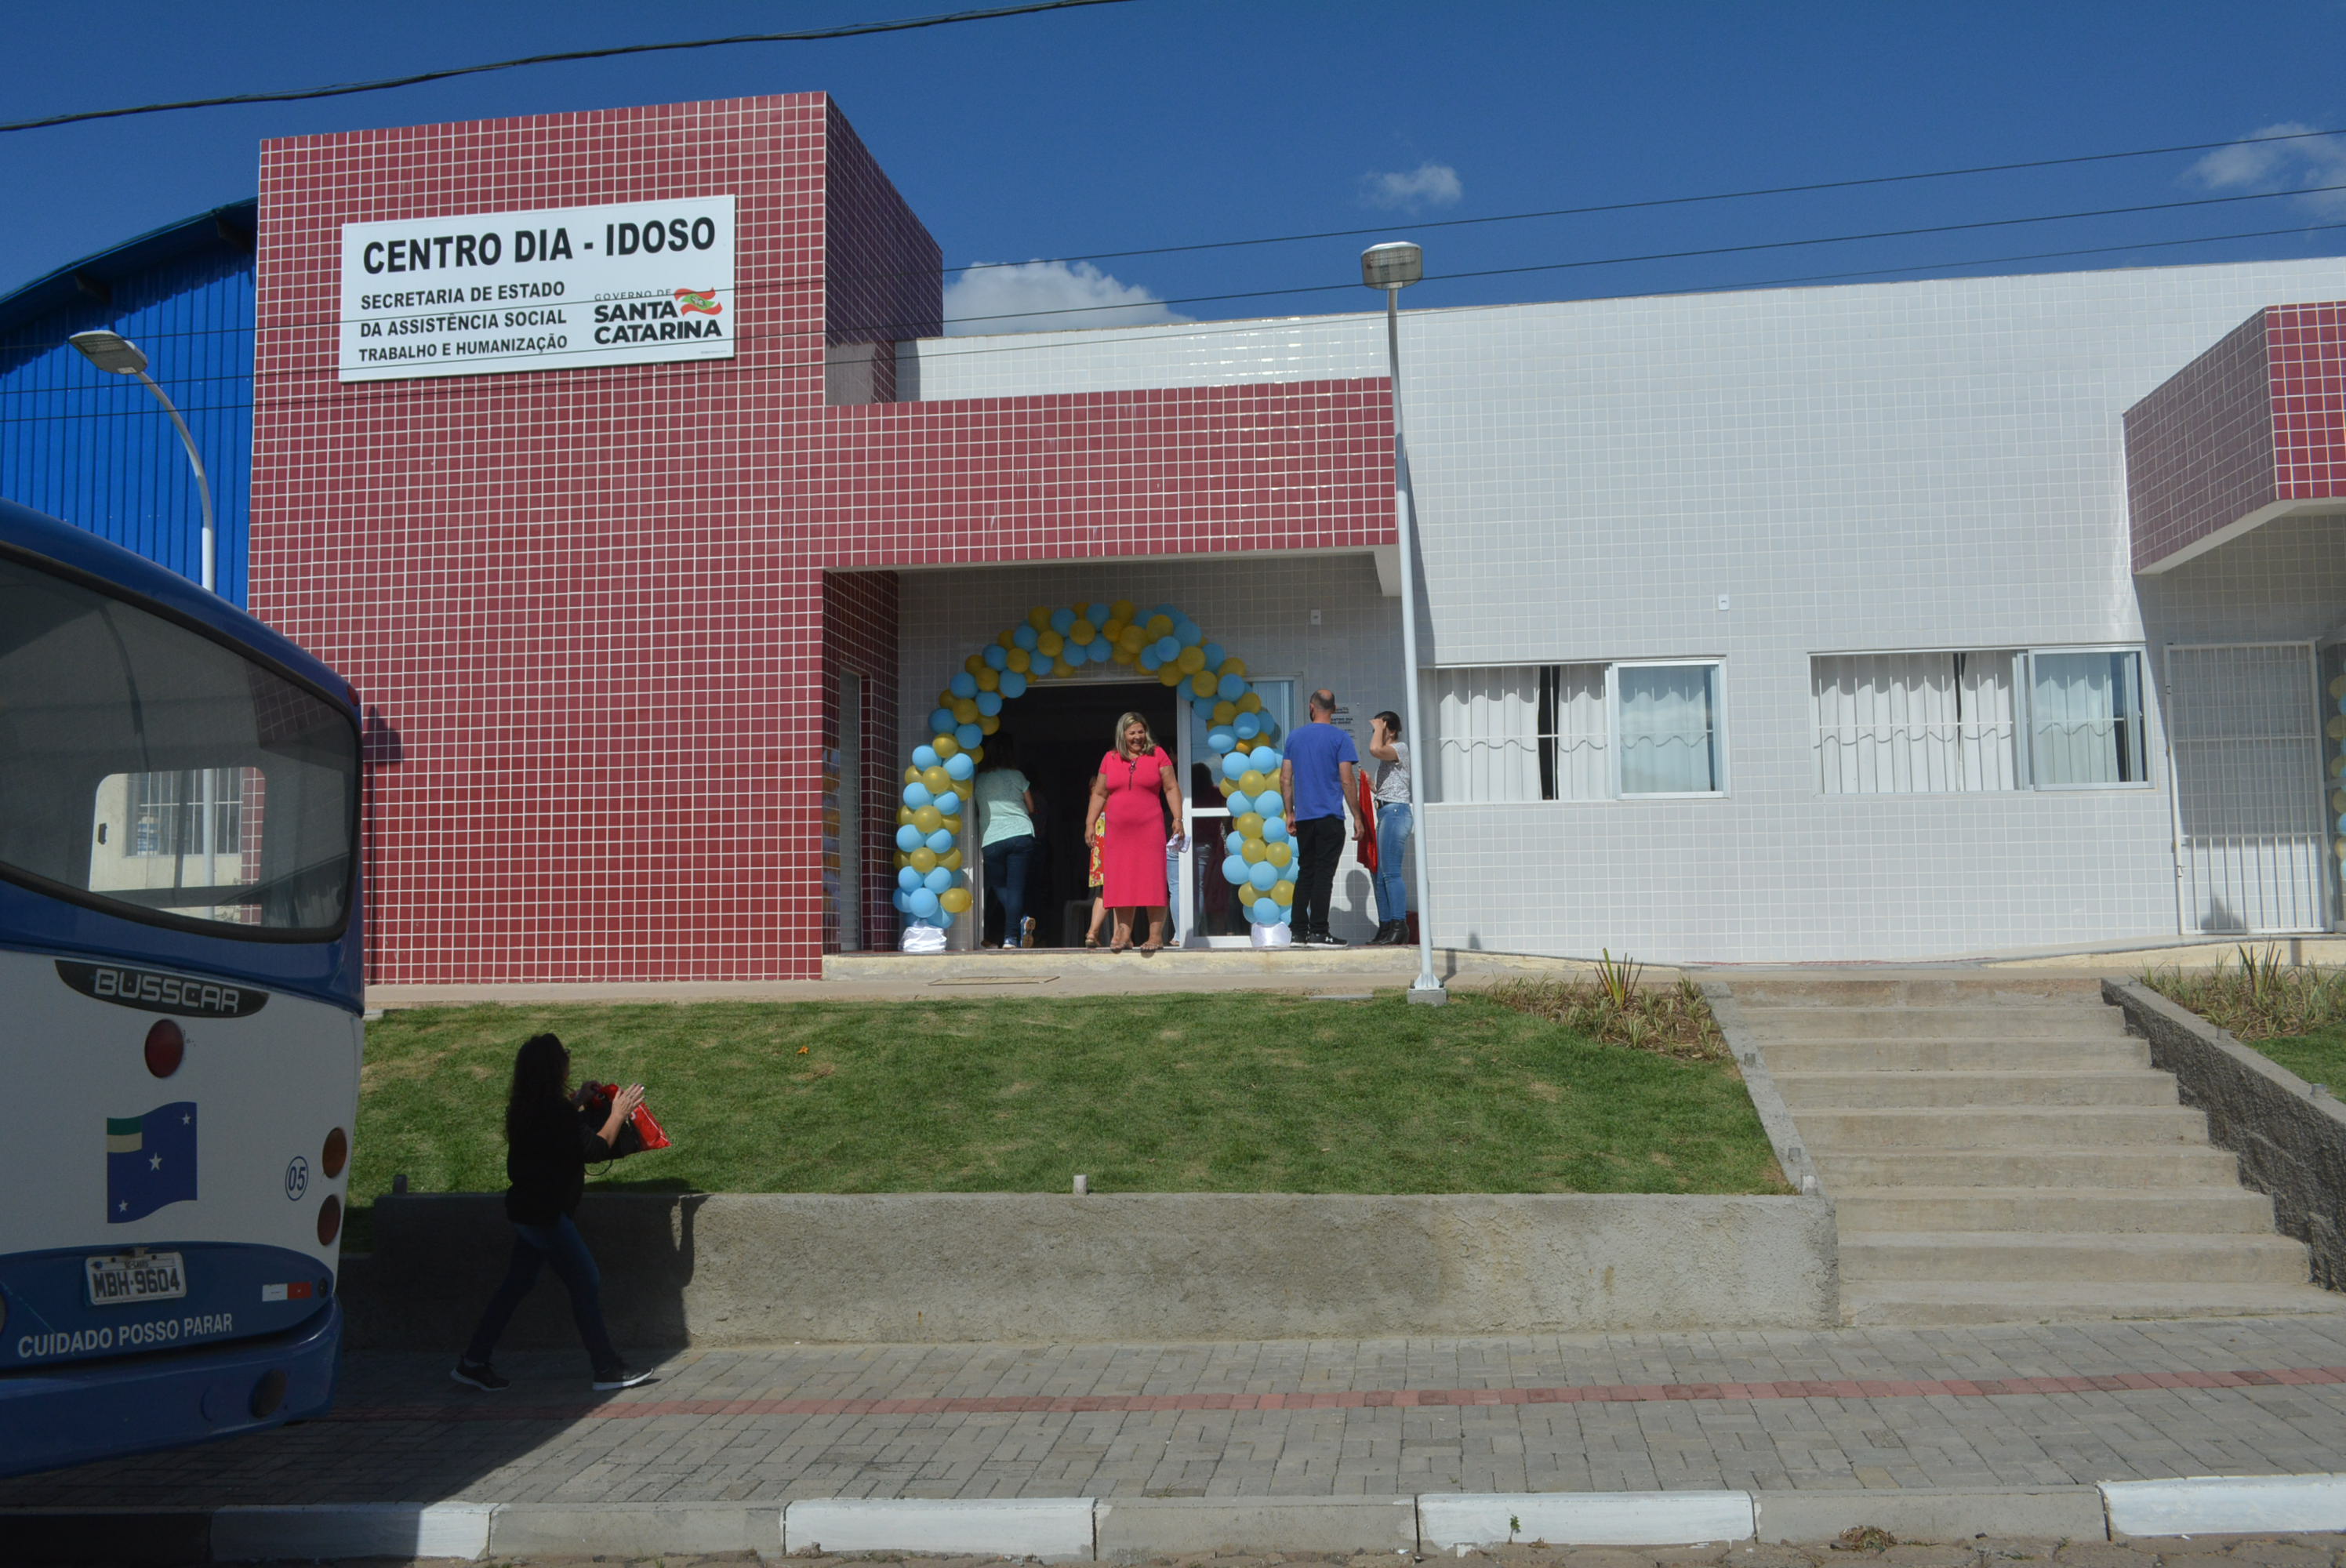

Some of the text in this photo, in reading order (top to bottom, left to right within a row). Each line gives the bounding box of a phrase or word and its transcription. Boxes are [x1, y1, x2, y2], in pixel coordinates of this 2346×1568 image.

[364, 233, 502, 274] CENTRO
[514, 227, 573, 263] DIA
[606, 217, 715, 256] IDOSO
[361, 281, 565, 310] SECRETARIA DE ESTADO
[594, 290, 652, 301] GOVERNO
[361, 310, 567, 337] DA ASSISTÊNCIA SOCIAL
[594, 300, 678, 323] SANTA
[594, 319, 722, 345] CATARINA
[359, 334, 568, 362] TRABALHO E HUMANIZAÇÃO
[94, 968, 239, 1013] BUSSCAR
[289, 1165, 306, 1192] 05
[18, 1313, 233, 1359] CUIDADO POSSO PARAR
